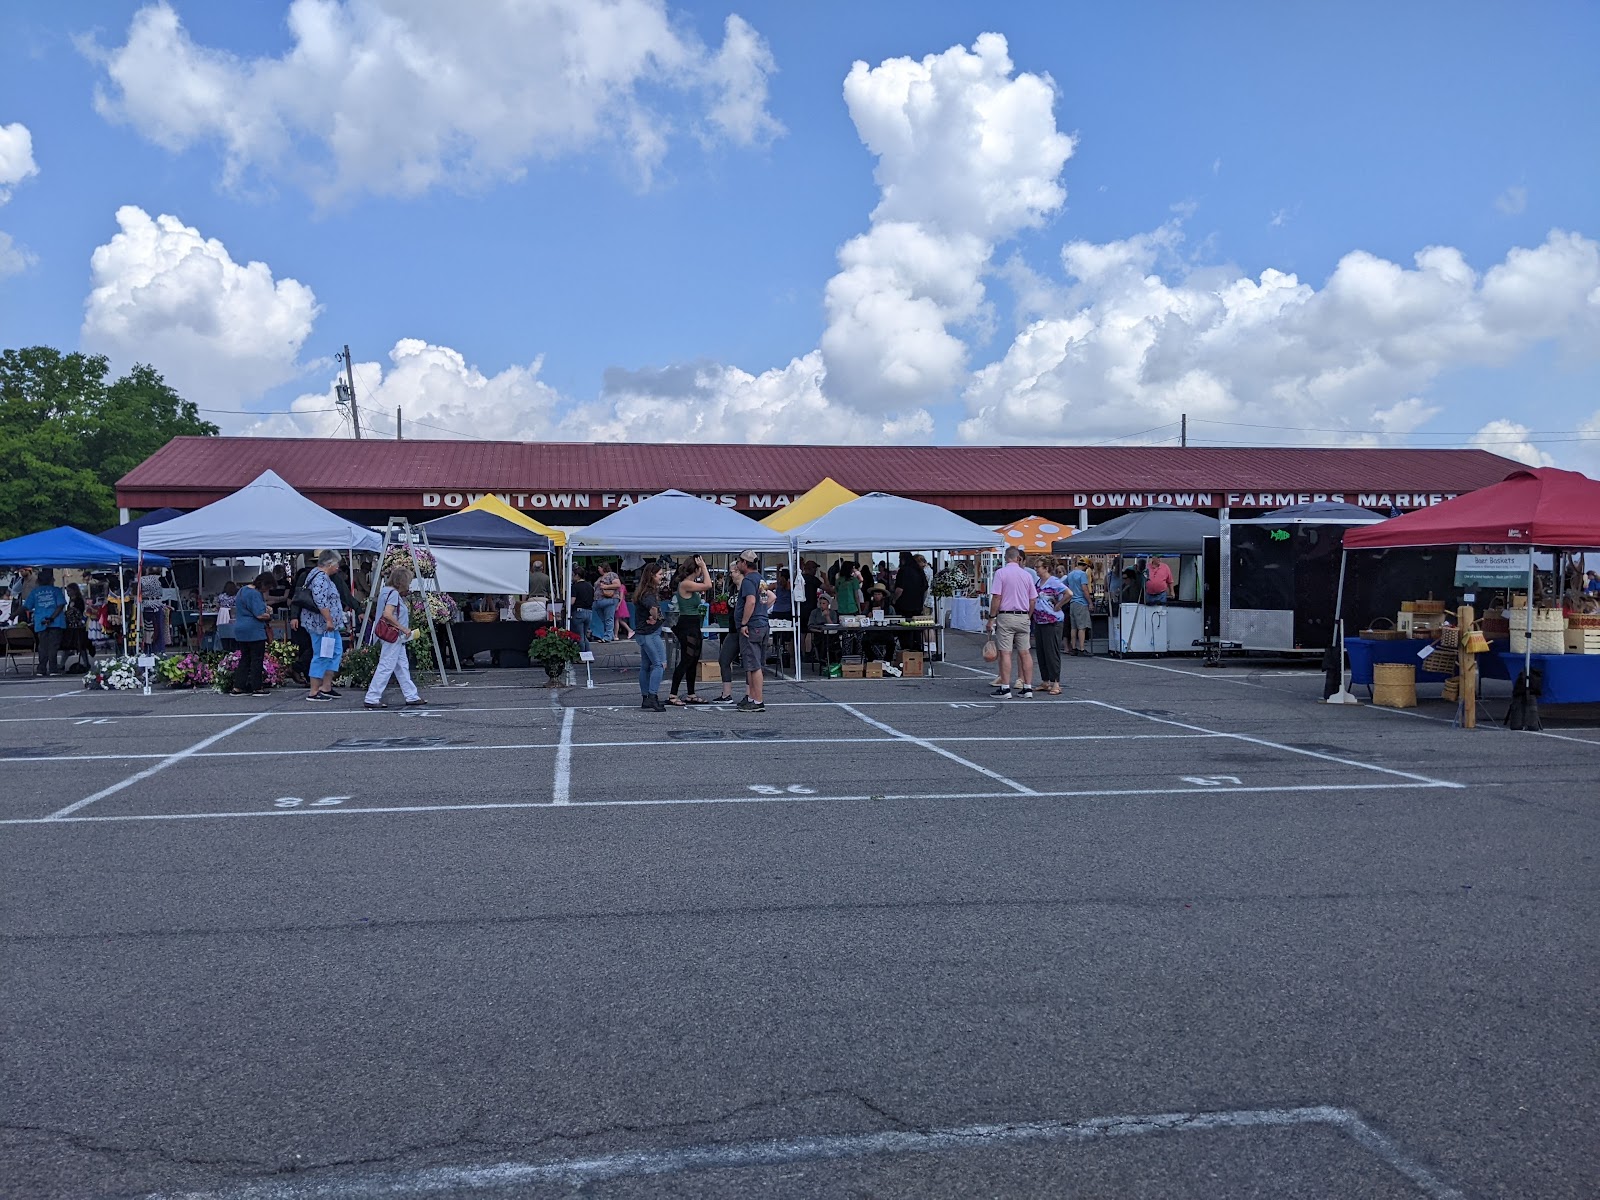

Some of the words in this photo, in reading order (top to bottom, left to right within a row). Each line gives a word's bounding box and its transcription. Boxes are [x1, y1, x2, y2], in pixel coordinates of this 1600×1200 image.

[601, 493, 737, 508] FARS
[1073, 493, 1212, 507] DOWNTOWN
[1227, 493, 1345, 507] FARMERS
[746, 783, 819, 795] 86
[273, 796, 352, 808] 85
